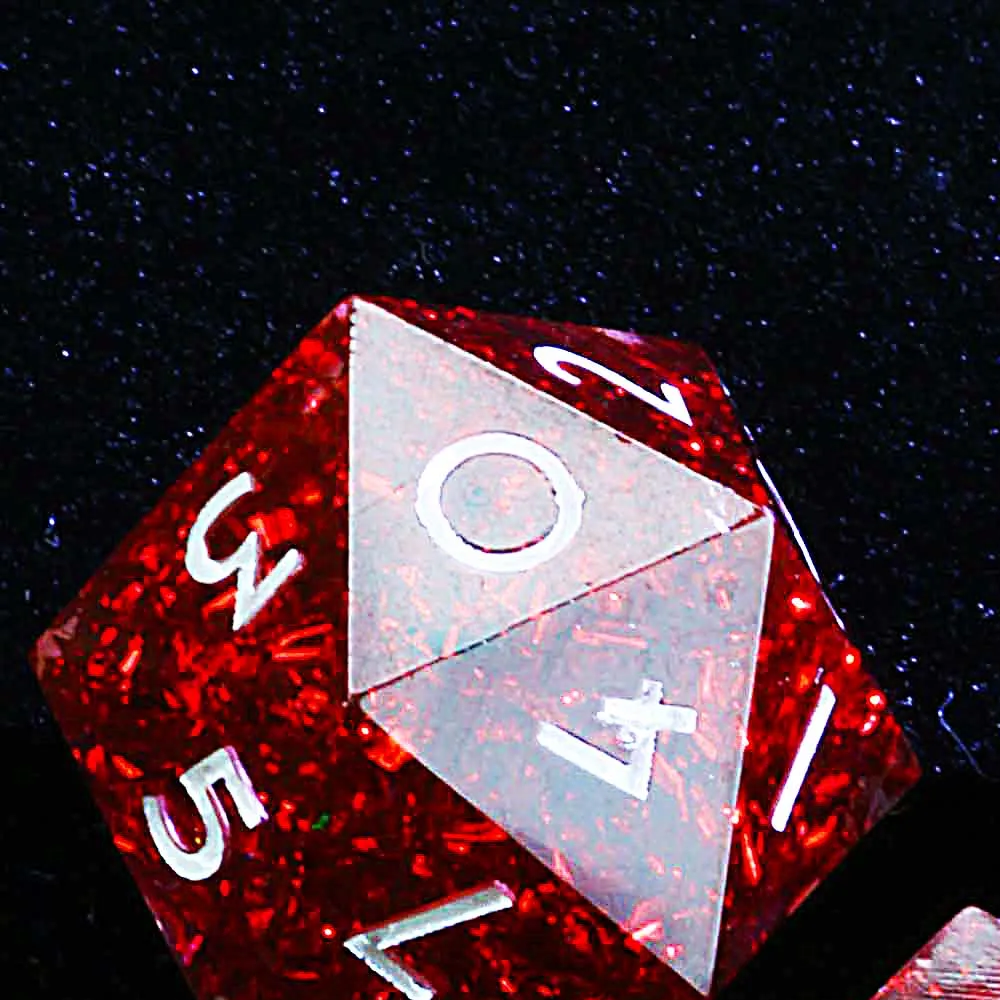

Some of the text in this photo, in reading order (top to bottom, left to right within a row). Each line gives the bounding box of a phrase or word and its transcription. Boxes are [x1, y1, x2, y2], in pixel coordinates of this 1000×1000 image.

[533, 346, 694, 427] 2
[184, 471, 305, 632] 3
[416, 431, 588, 573] 0
[536, 680, 698, 801] 4
[771, 684, 837, 832] 1
[142, 746, 268, 883] 5
